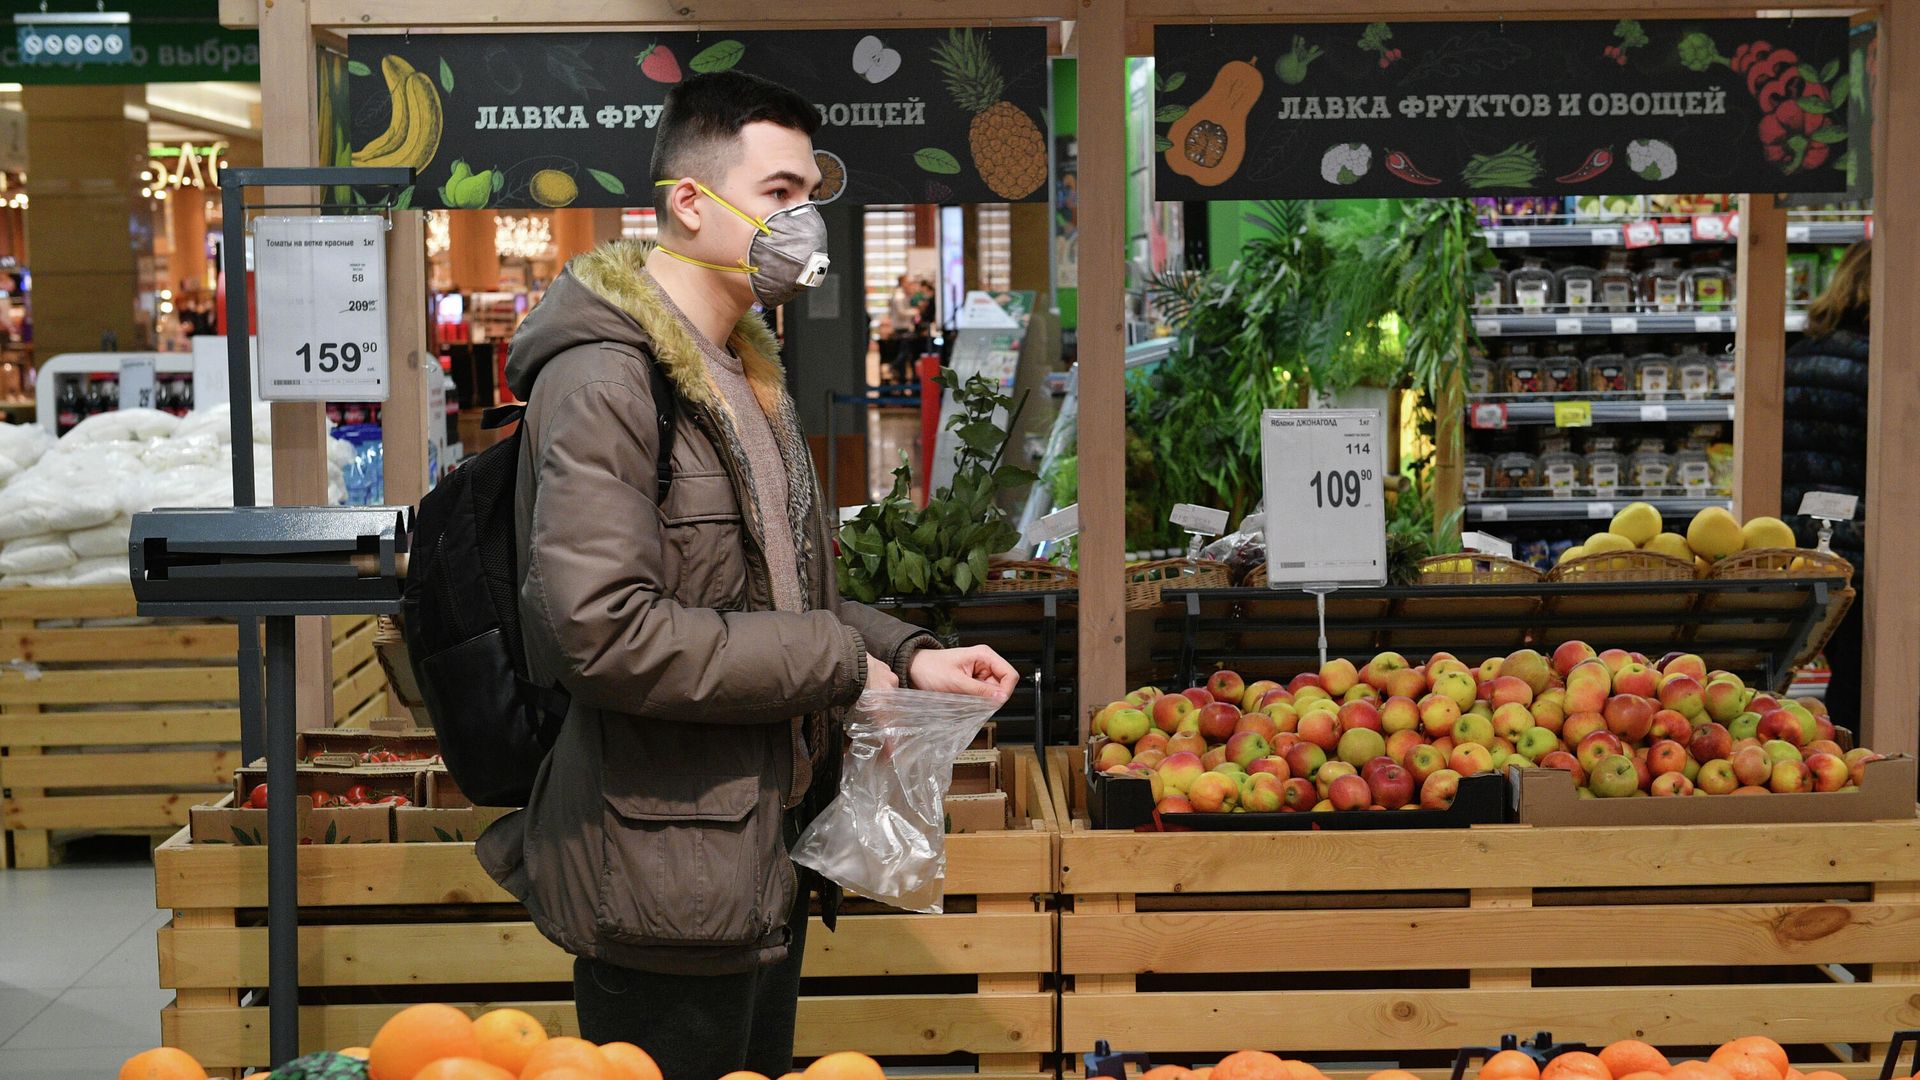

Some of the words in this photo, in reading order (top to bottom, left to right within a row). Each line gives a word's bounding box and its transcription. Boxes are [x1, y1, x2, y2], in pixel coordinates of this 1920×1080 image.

[1278, 96, 1391, 120] ЛАВКА
[1399, 94, 1552, 118] ФРУКТОВ
[1558, 93, 1581, 116] И
[1588, 86, 1727, 117] ОВОЩЕЙ
[475, 106, 589, 130] ЛАВКА
[266, 239, 292, 247] Томаты
[324, 239, 354, 248] красные
[363, 238, 375, 247] 1кг
[351, 274, 364, 282] 58
[295, 342, 361, 372] 159
[1296, 419, 1337, 427] ДЖОНАГОЛД
[1345, 443, 1370, 454] 114
[1310, 470, 1360, 508] 109
